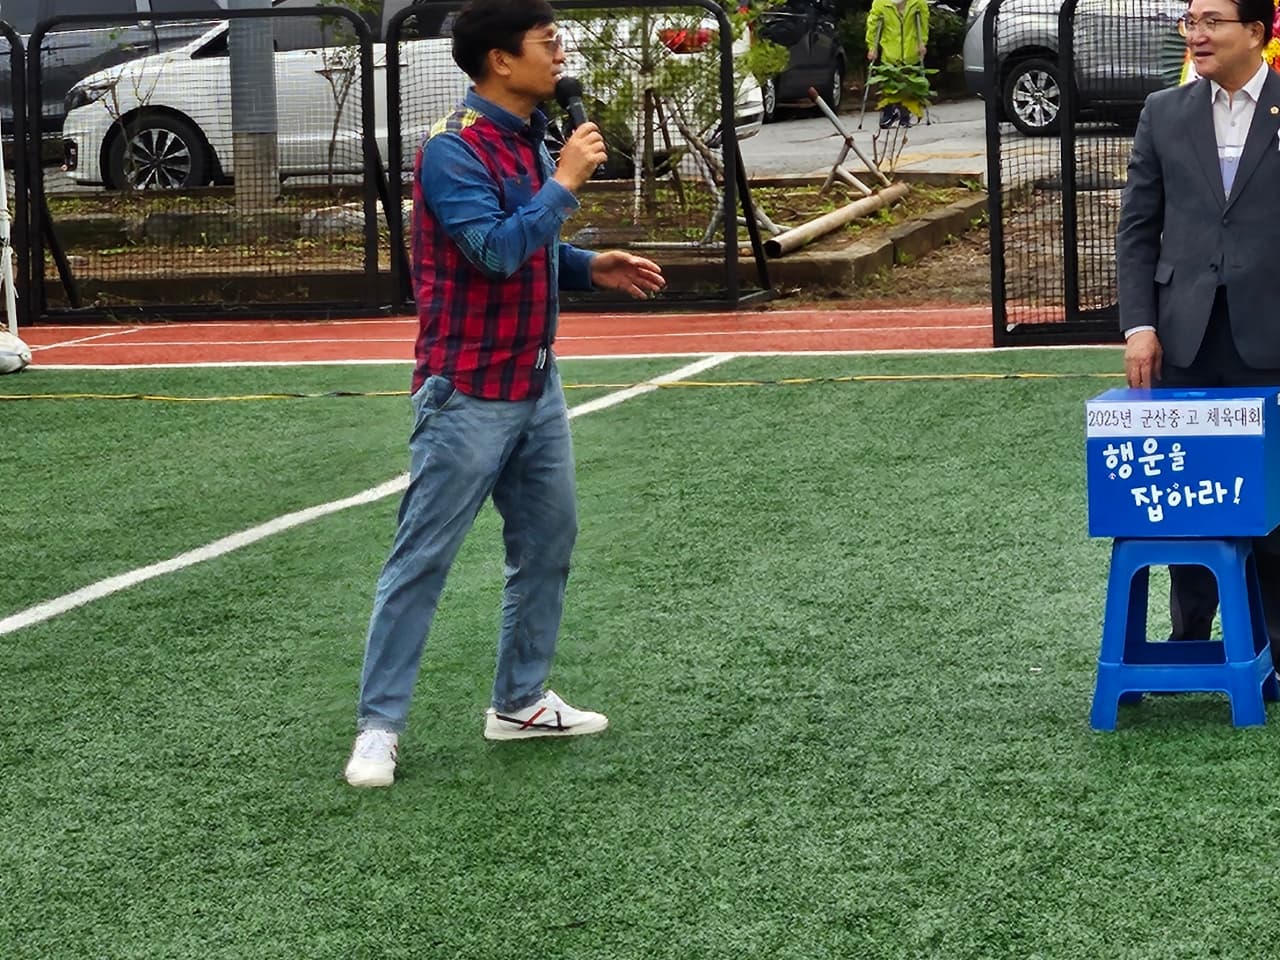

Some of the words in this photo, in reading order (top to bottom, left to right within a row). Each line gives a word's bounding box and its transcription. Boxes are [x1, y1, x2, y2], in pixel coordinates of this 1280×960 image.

[1088, 408, 1132, 429] 2025년
[1206, 406, 1261, 428] 체육대회
[1102, 437, 1187, 480] 행운을
[1130, 476, 1244, 523] 잡아라!
